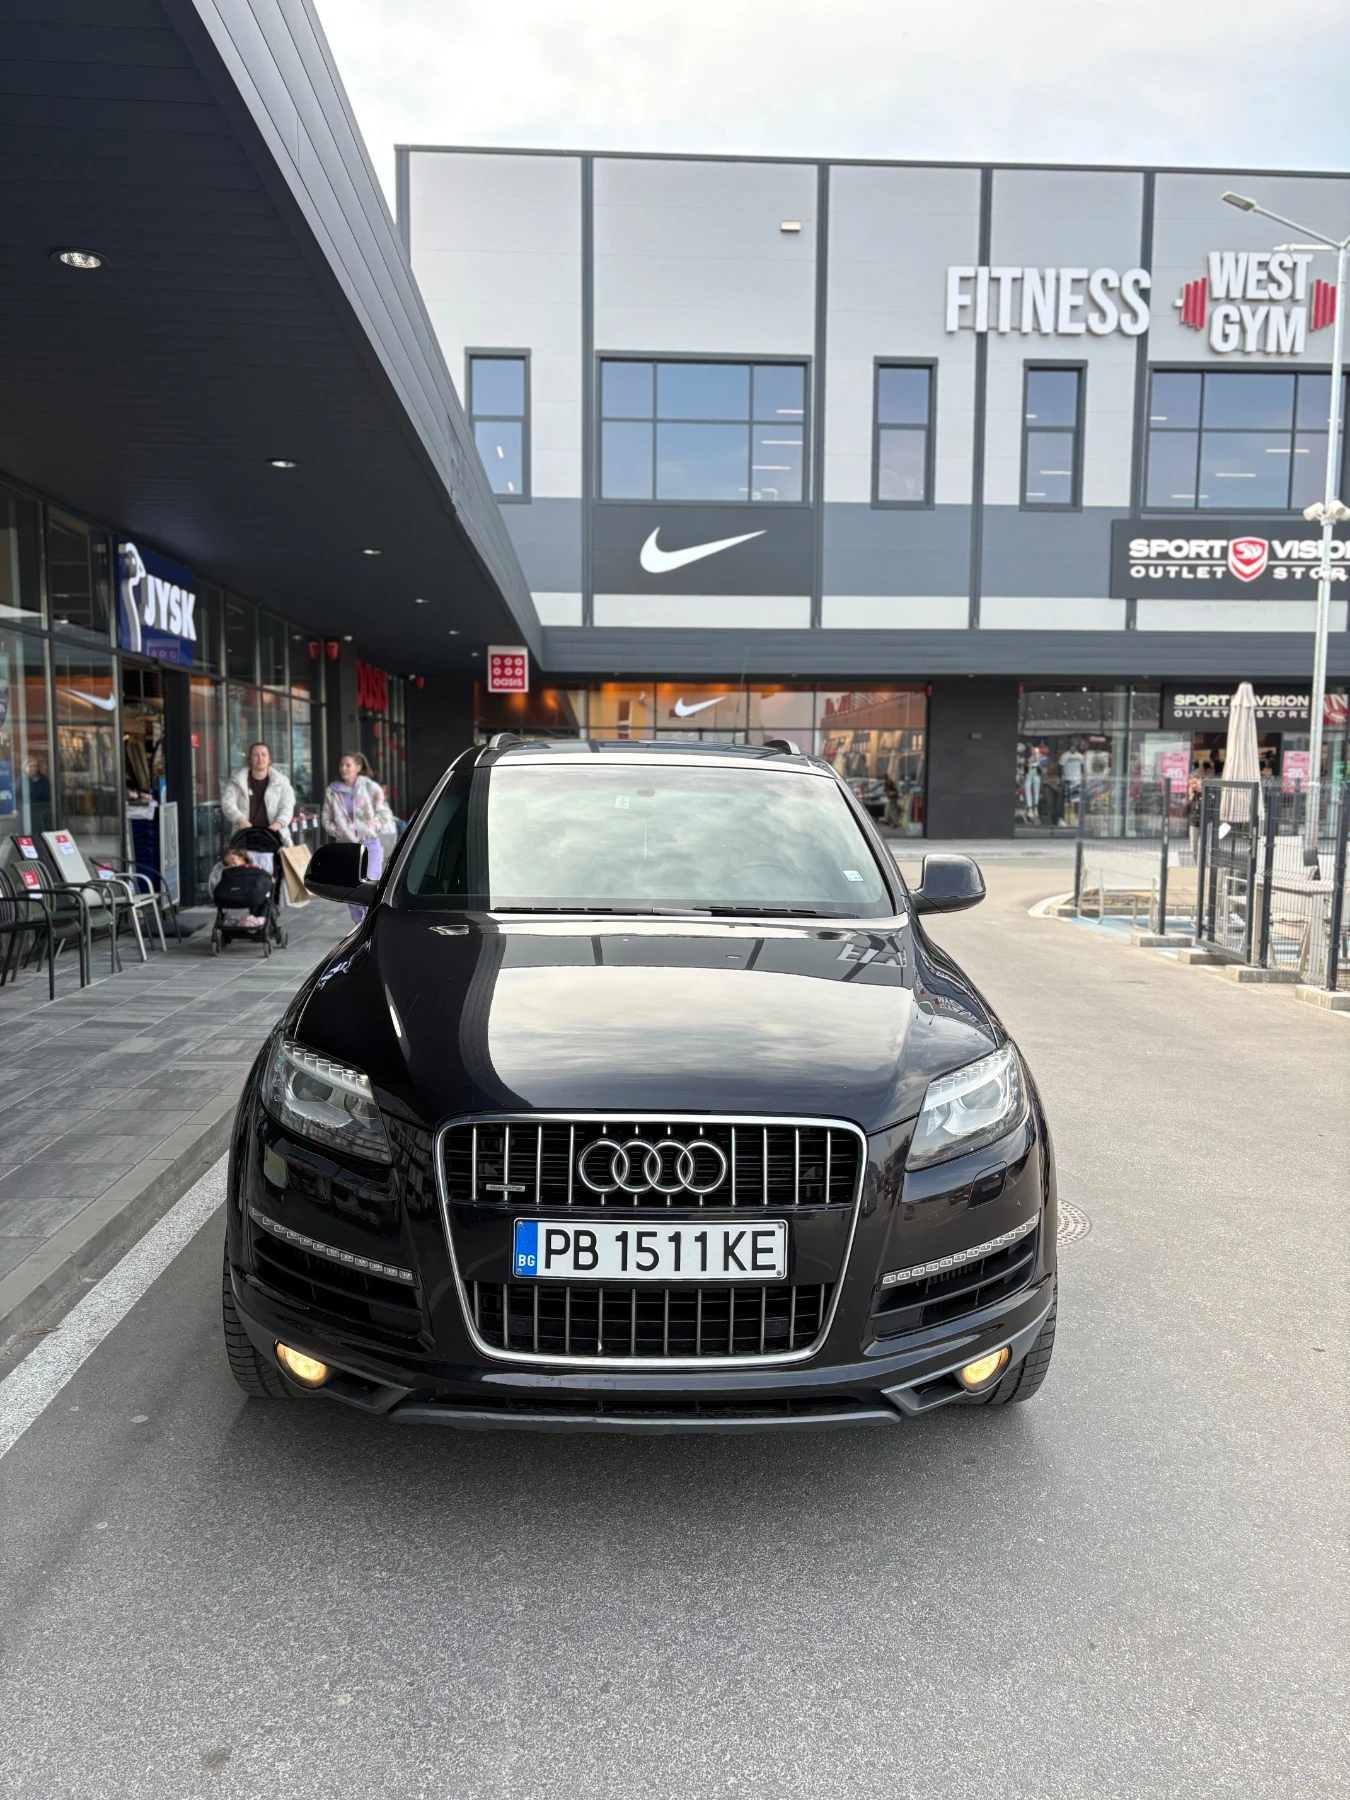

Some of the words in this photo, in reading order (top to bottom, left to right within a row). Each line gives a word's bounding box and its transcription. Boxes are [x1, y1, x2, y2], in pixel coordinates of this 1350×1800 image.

[1208, 251, 1314, 300] WEST
[945, 265, 1152, 337] FITNESS
[1209, 304, 1307, 354] GYM
[1129, 538, 1229, 559] SPORT
[1129, 565, 1227, 579] OUTLET
[143, 573, 197, 642] JYSK
[1173, 694, 1229, 706] SPORT
[1256, 695, 1310, 707] VISION
[1173, 709, 1229, 718] OUTLET
[1256, 710, 1309, 719] STORE
[517, 1253, 536, 1267] BG
[543, 1228, 599, 1271] PB
[614, 1230, 708, 1272] 1511
[722, 1230, 777, 1272] KE
